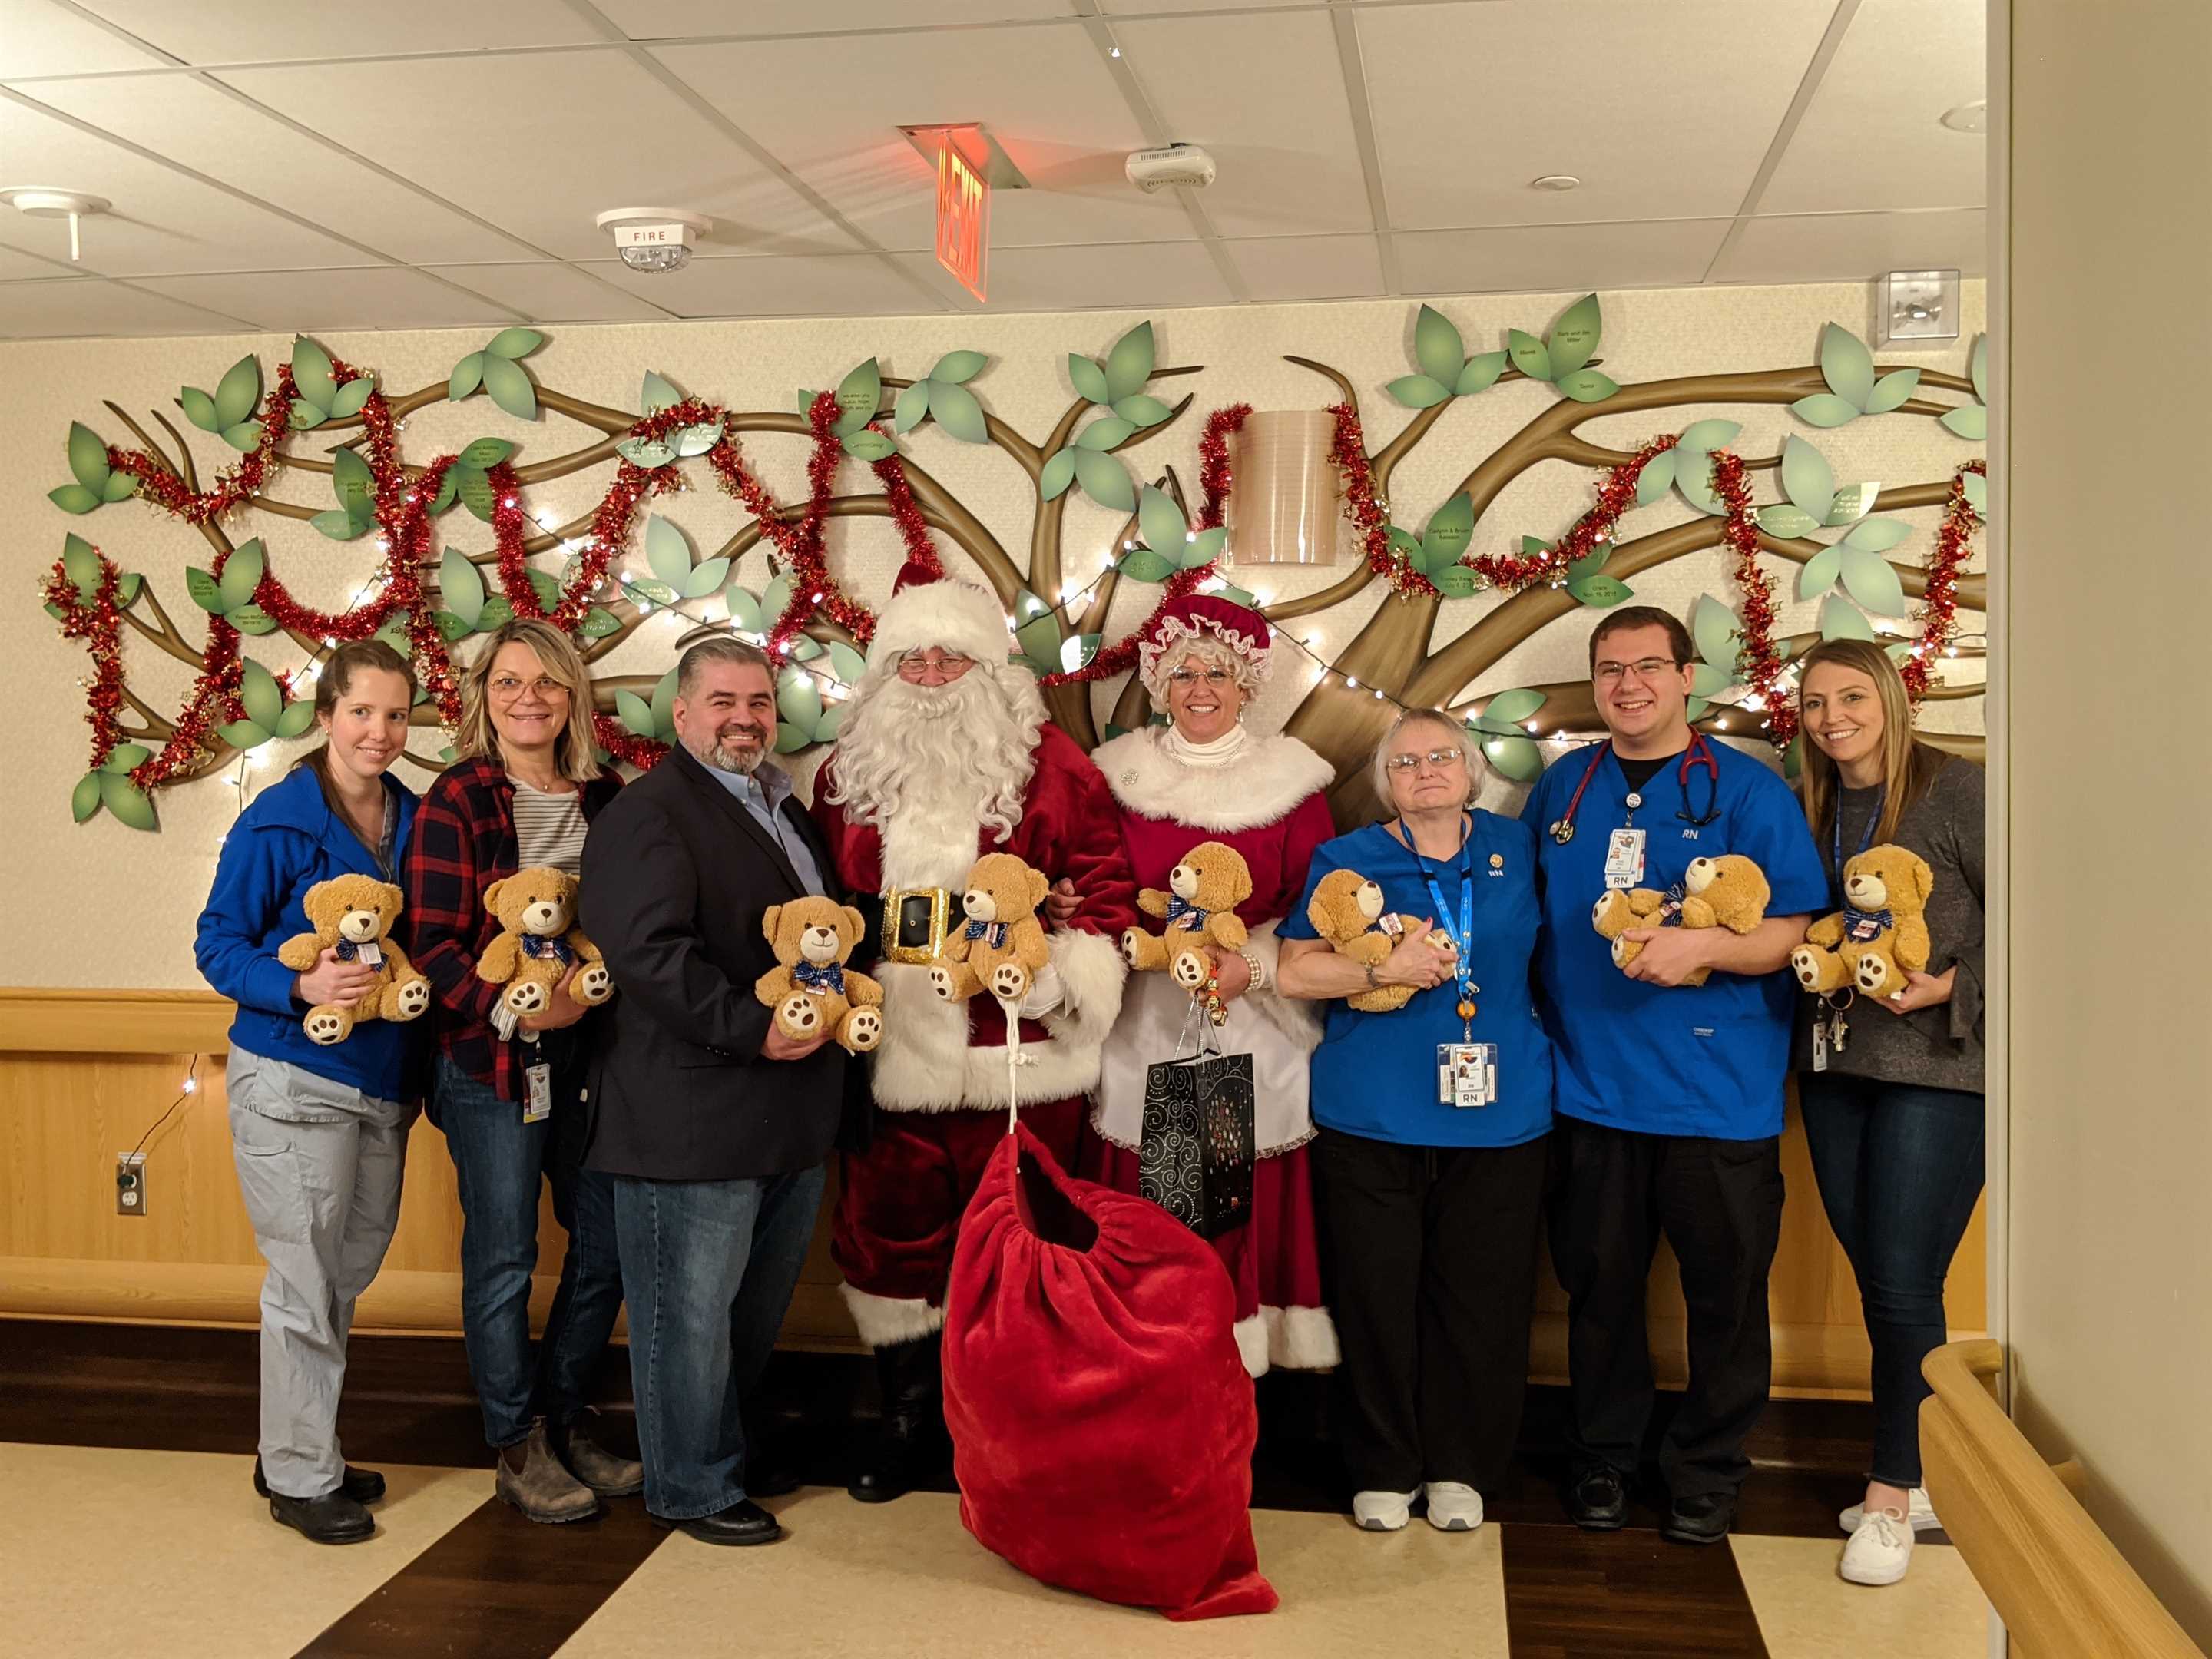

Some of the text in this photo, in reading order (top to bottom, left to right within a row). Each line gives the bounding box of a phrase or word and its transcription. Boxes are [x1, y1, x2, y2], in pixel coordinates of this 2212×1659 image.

[948, 152, 983, 284] EXIT
[634, 231, 665, 241] FIRE
[1682, 829, 1698, 839] RN
[1614, 876, 1628, 885] RN
[1463, 1094, 1478, 1103] RN
